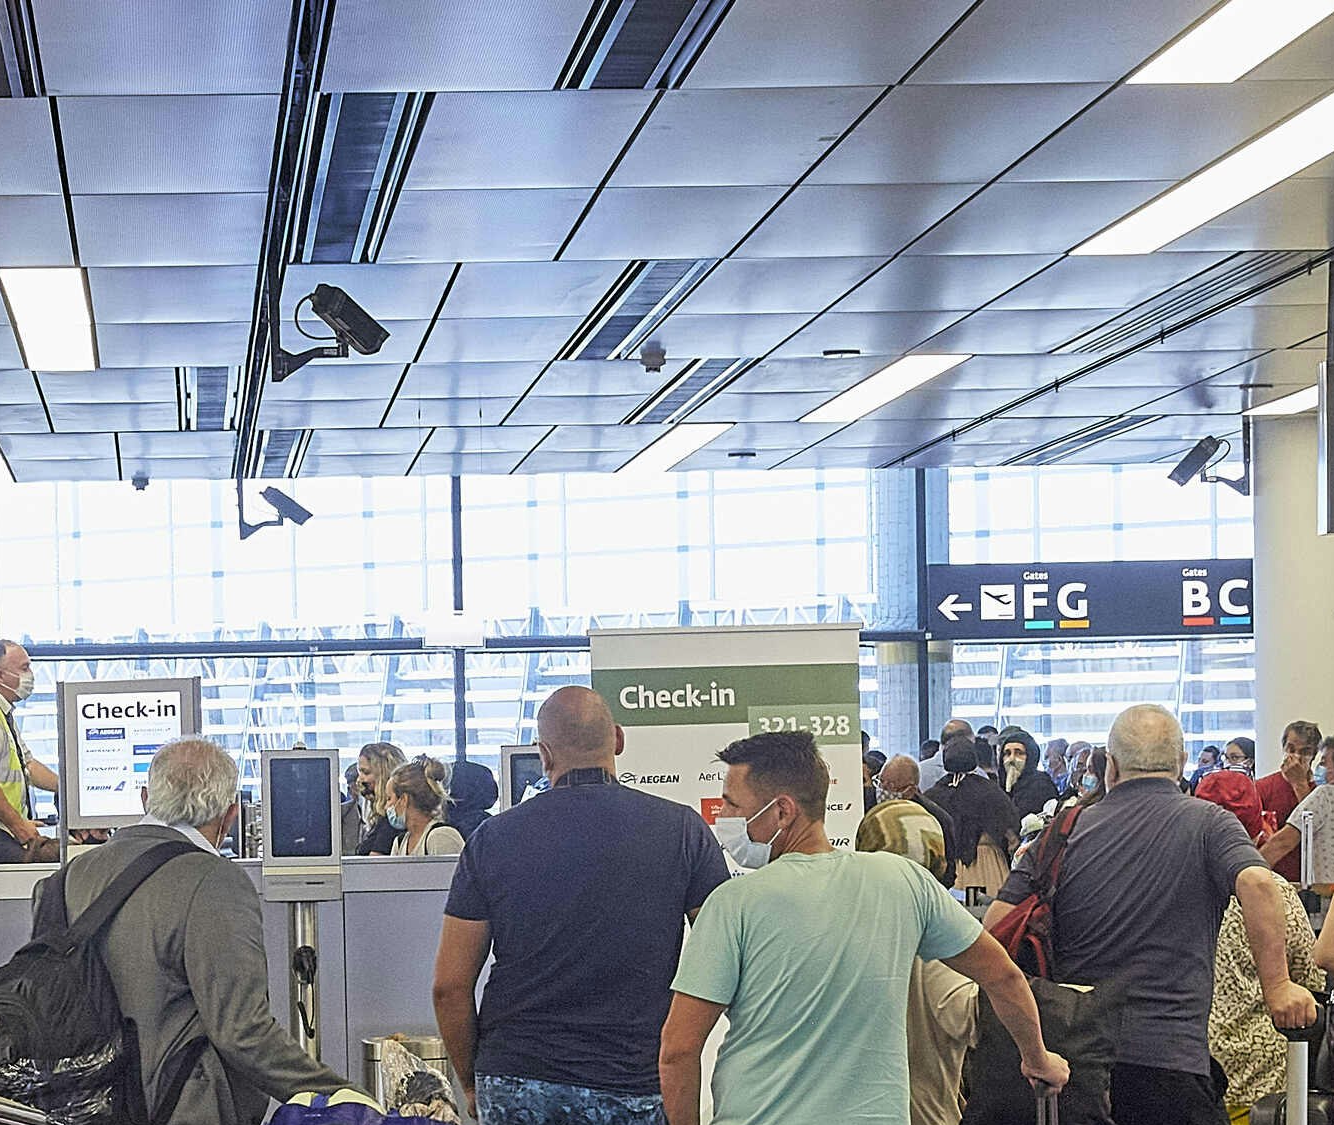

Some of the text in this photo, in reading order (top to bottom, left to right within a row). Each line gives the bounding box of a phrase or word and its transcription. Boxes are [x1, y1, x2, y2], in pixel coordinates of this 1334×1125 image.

[1023, 571, 1049, 581] Gates
[1182, 567, 1208, 578] Gates
[619, 681, 736, 710] Check-in
[81, 699, 177, 719] Check-in
[639, 774, 680, 785] AEGEAN
[699, 772, 716, 781] Aer
